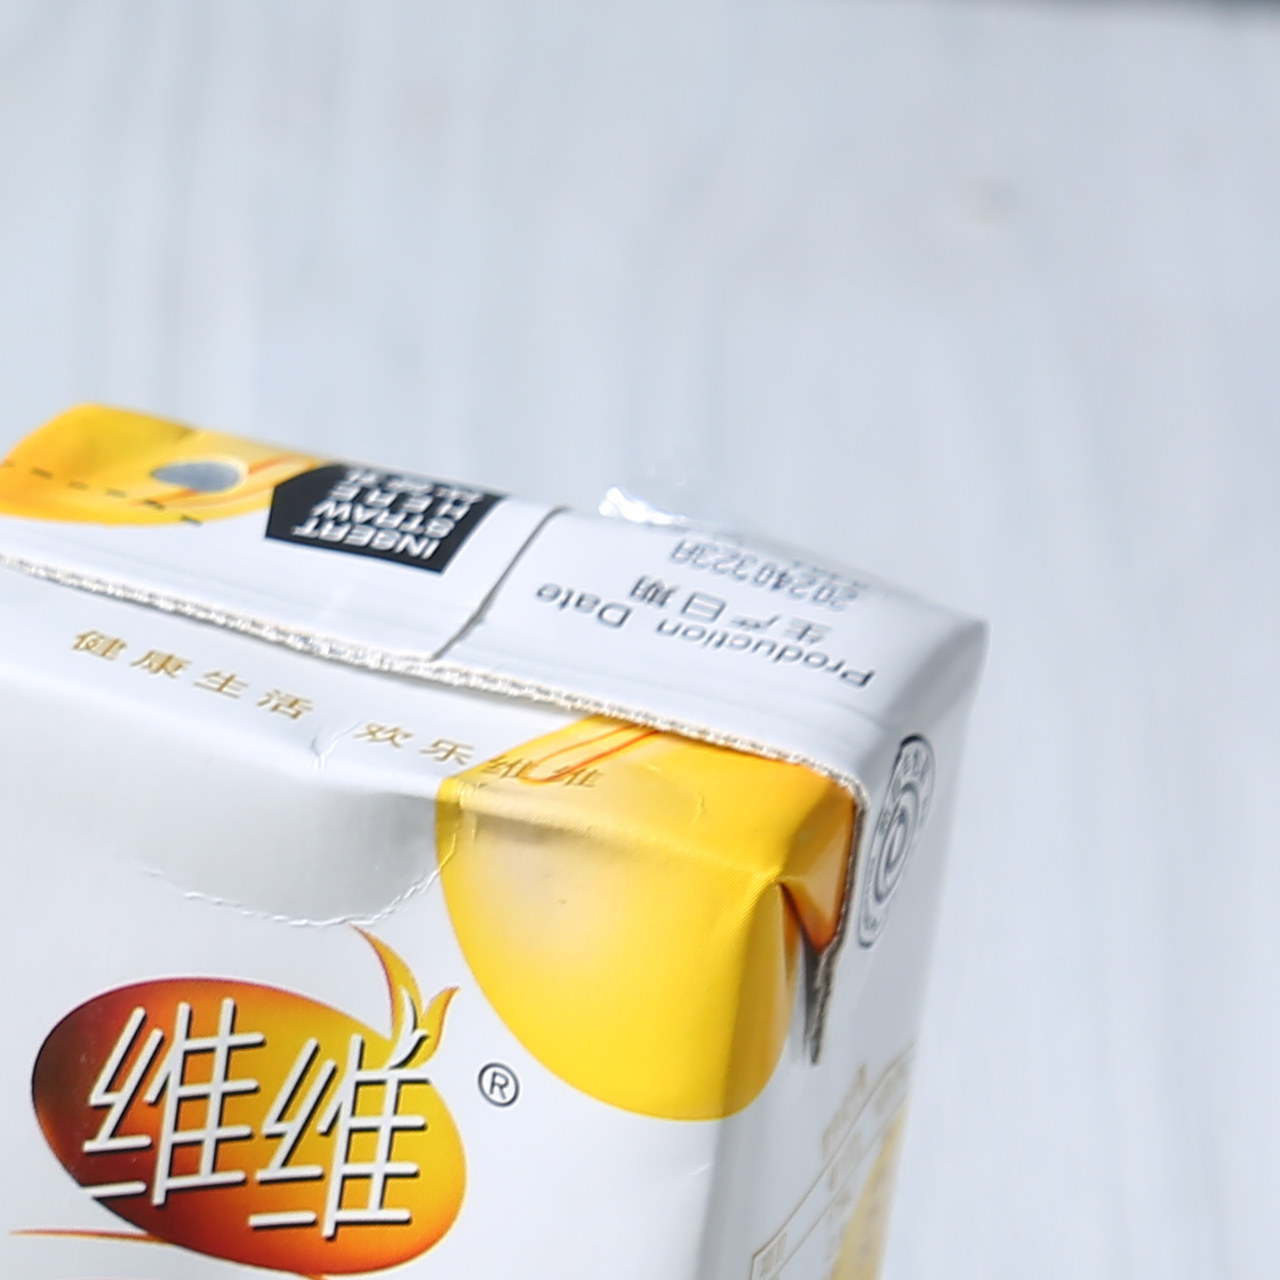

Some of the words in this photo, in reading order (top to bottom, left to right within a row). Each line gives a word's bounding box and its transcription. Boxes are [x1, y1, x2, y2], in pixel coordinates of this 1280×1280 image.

[311, 500, 456, 539] STRAW
[330, 484, 472, 520] HERE
[293, 518, 441, 560] INSERT
[536, 582, 632, 629] Date
[629, 575, 832, 645] 生产日期
[72, 630, 313, 721] 健康生活
[656, 618, 876, 689] Production
[80, 985, 432, 1240] 维维
